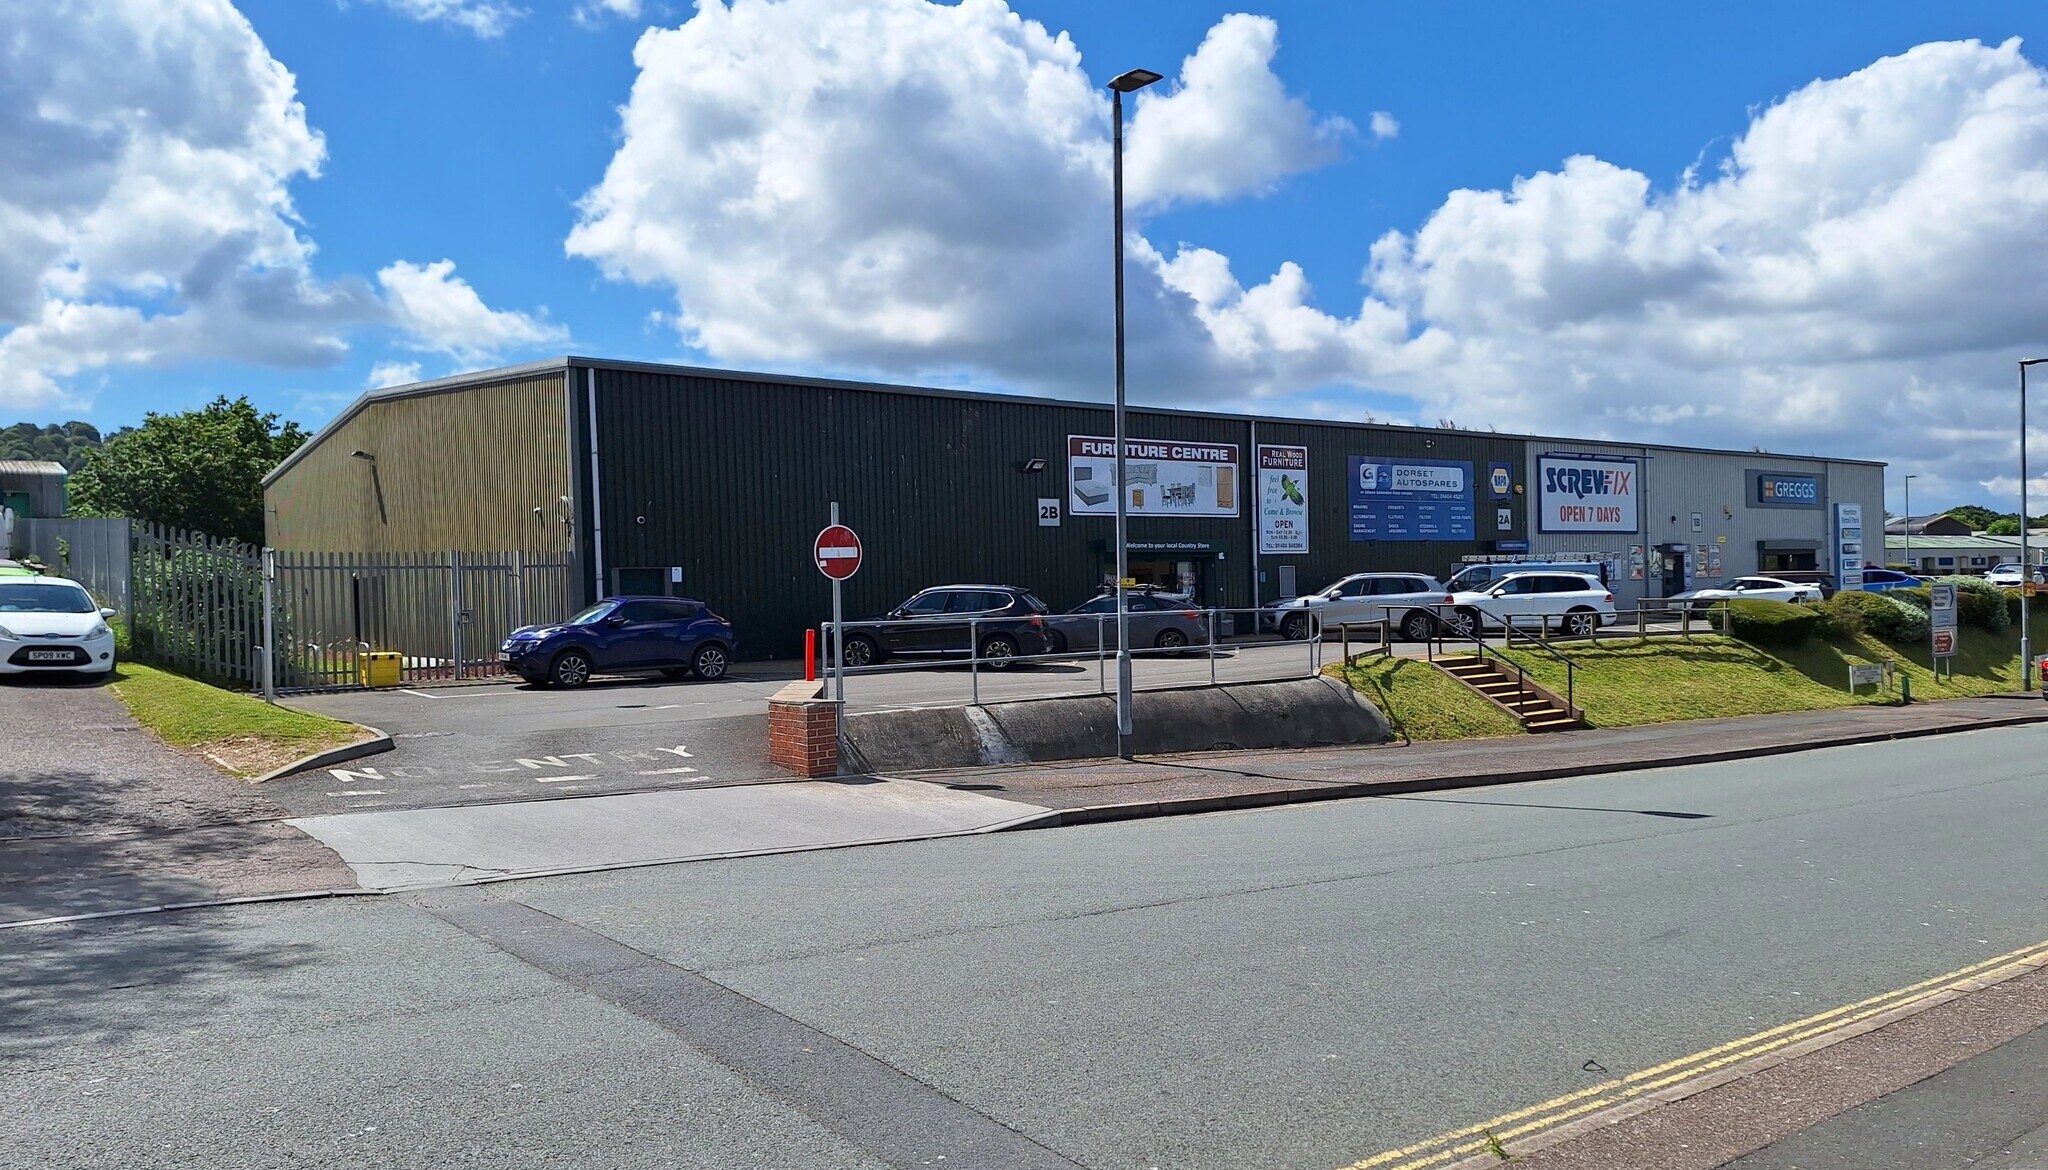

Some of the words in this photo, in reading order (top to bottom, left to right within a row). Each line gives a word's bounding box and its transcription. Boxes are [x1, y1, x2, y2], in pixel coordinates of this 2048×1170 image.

[1082, 442, 1168, 458] FURITURE
[1172, 446, 1228, 461] CENTRE
[1272, 450, 1286, 458] REAL
[1287, 451, 1303, 459] WOOD
[1263, 456, 1303, 467] FURNITURE
[1396, 480, 1458, 488] AUTOSPARES
[1546, 467, 1631, 500] SCREWFIX
[1775, 482, 1815, 498] GREGGS
[1040, 506, 1058, 519] 2B
[1560, 505, 1585, 522] OPEN
[1587, 506, 1594, 522] 7
[1597, 506, 1620, 522] DAYS
[1275, 520, 1293, 529] OPEN
[1499, 515, 1510, 524] 2A
